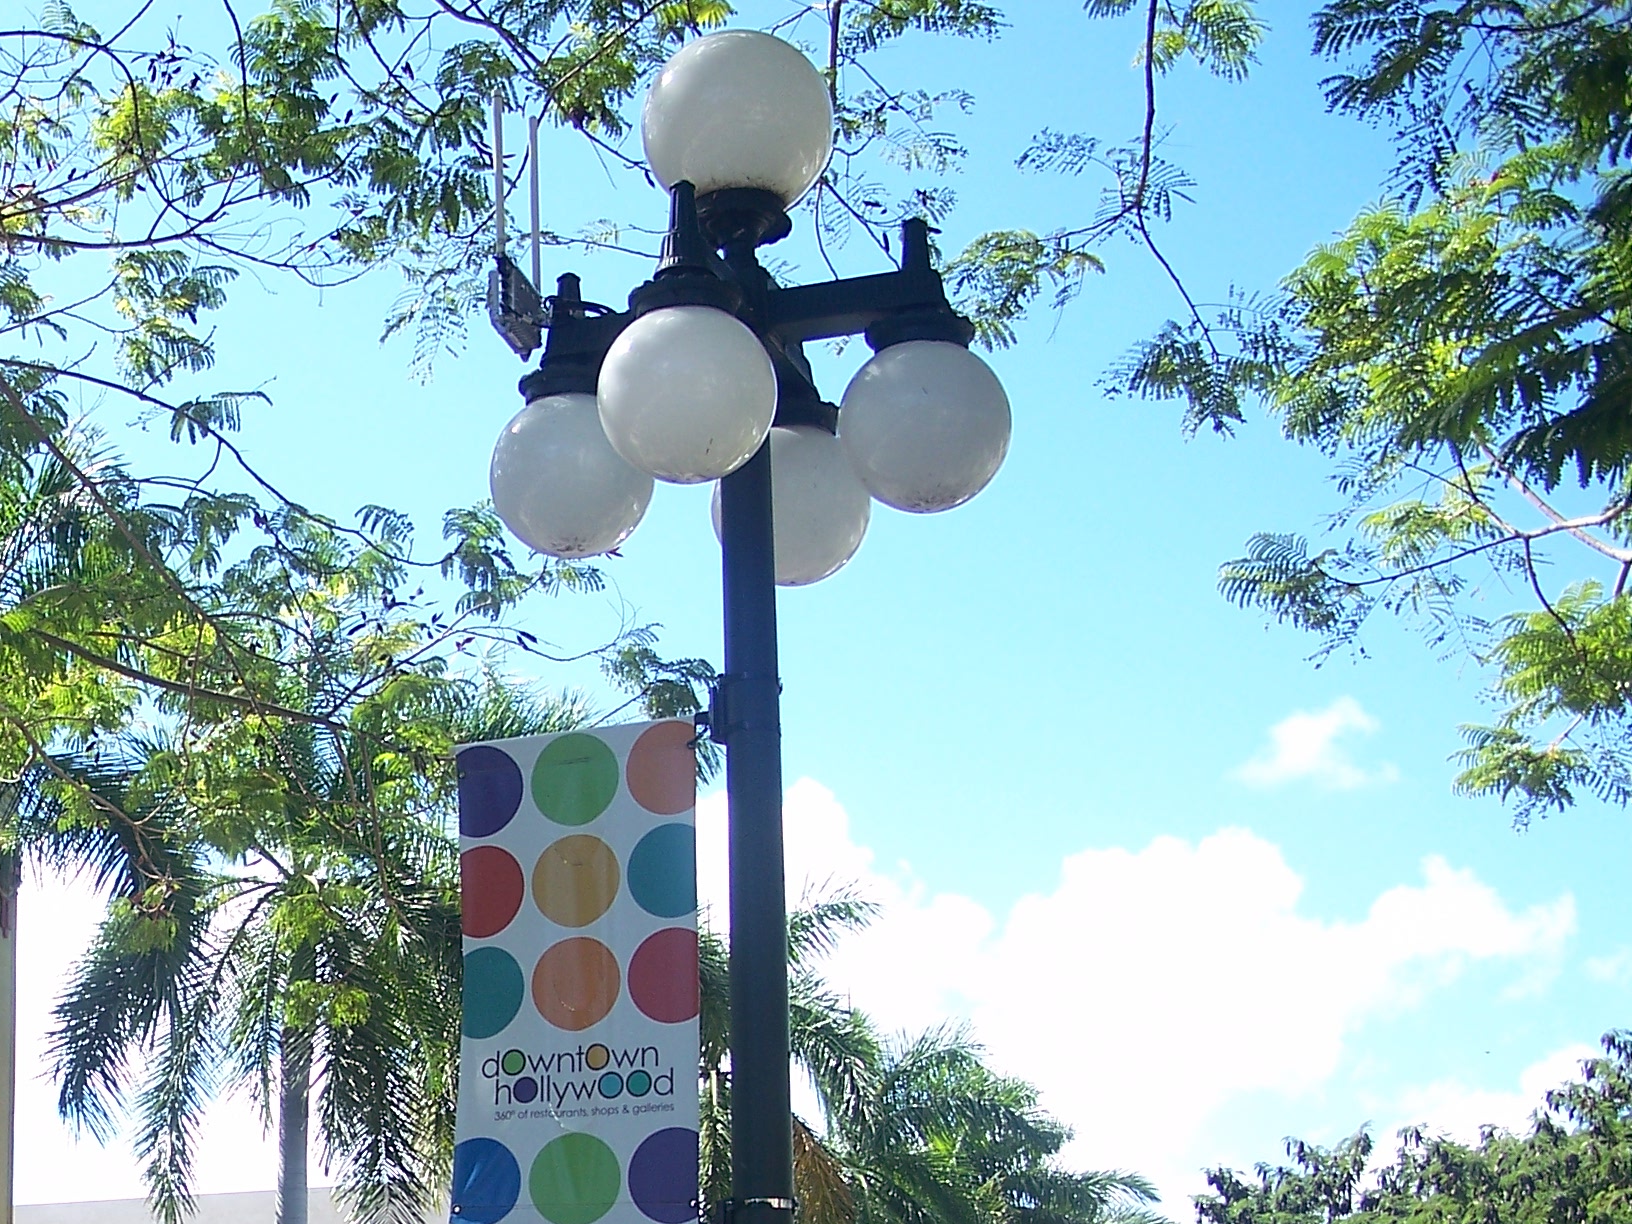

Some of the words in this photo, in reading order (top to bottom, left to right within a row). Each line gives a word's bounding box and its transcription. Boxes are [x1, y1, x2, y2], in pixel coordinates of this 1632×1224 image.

[481, 1042, 660, 1079] downtown
[494, 1066, 675, 1109] hollywood
[517, 1109, 528, 1119] of
[591, 1104, 619, 1117] shops
[622, 1102, 630, 1115] &
[632, 1101, 675, 1116] galleries
